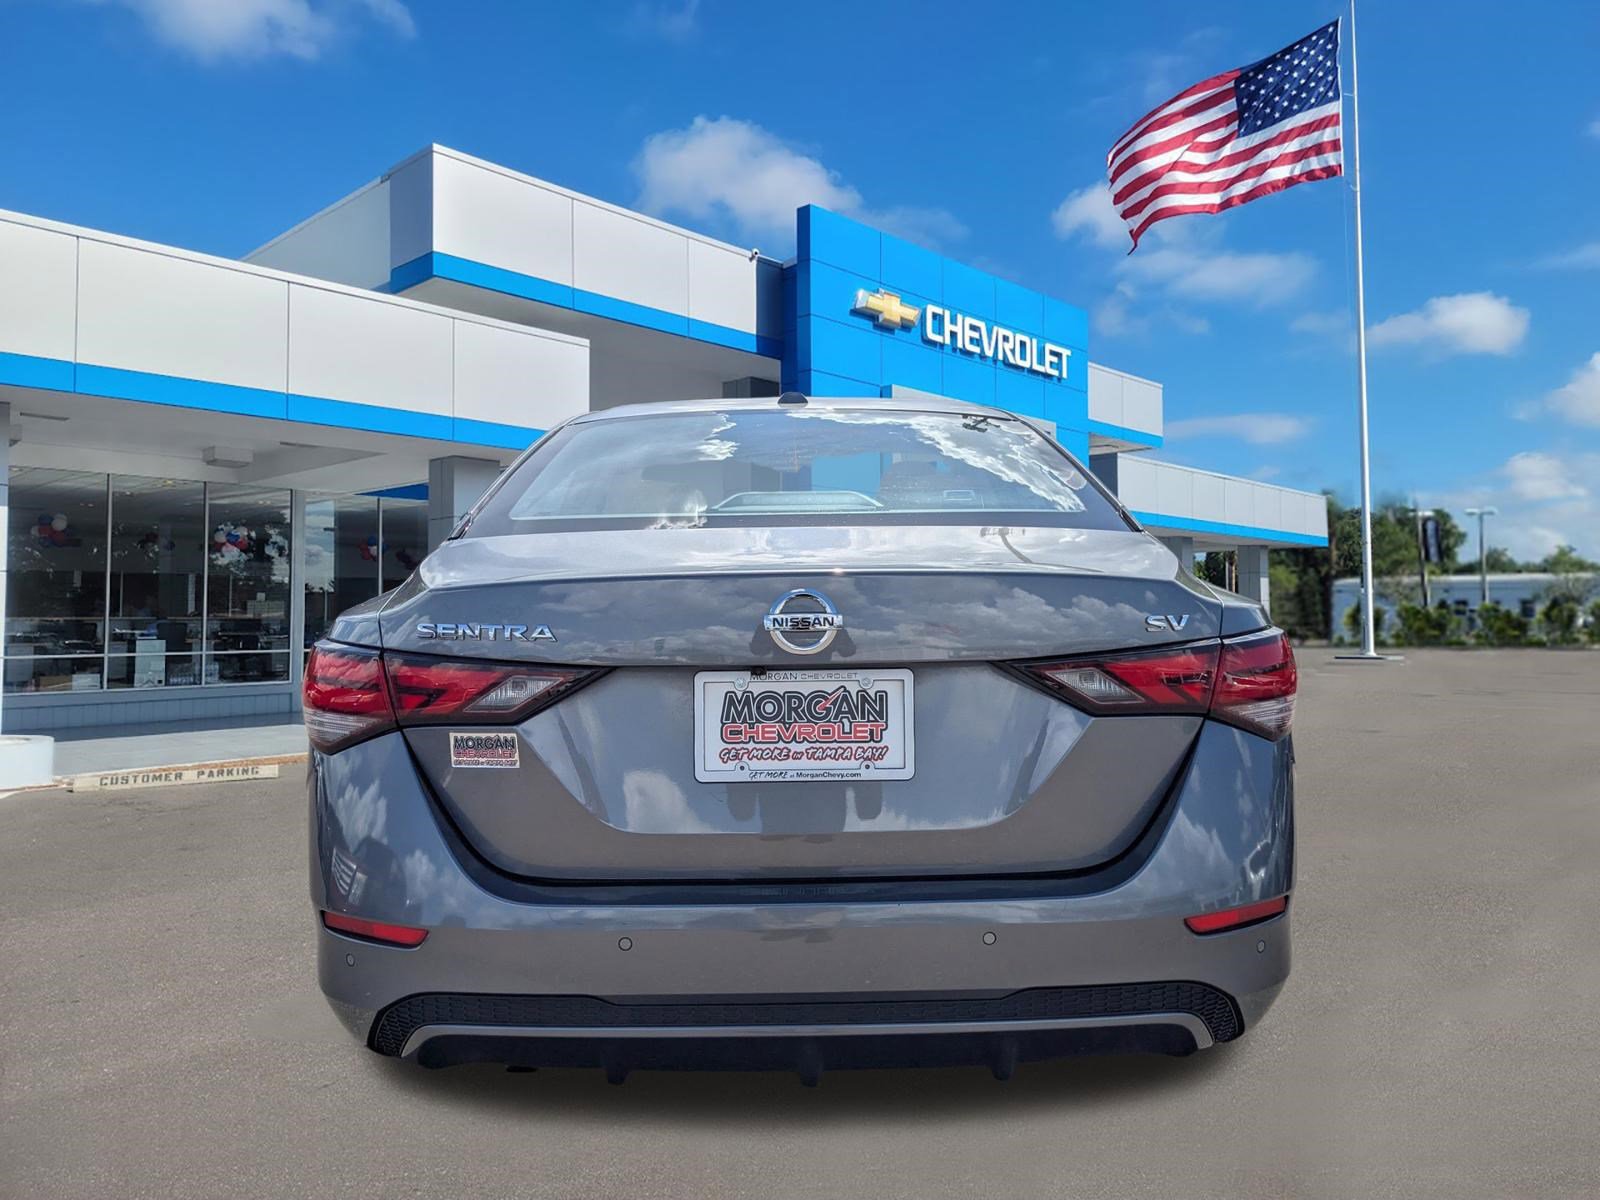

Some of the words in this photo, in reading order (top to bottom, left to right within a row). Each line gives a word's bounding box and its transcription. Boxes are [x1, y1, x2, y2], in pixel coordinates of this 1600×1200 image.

[925, 304, 1072, 379] CHEVROLET
[772, 616, 834, 628] NISSAN
[1145, 614, 1190, 632] SV
[416, 623, 558, 642] SENTRA
[800, 672, 858, 680] CHEVROLET
[721, 687, 888, 723] MORGAN
[453, 735, 516, 750] MORGAN
[721, 722, 888, 744] CHEVROLET
[719, 748, 749, 764] GET
[749, 747, 790, 761] MORE
[805, 746, 852, 761] TAMPA
[855, 745, 888, 761] BAY!
[100, 771, 183, 787] CUSTOMER
[196, 766, 260, 780] PARKING
[749, 771, 764, 781] GET
[765, 771, 788, 780] MORE
[796, 771, 861, 780] MorganChevy.com
